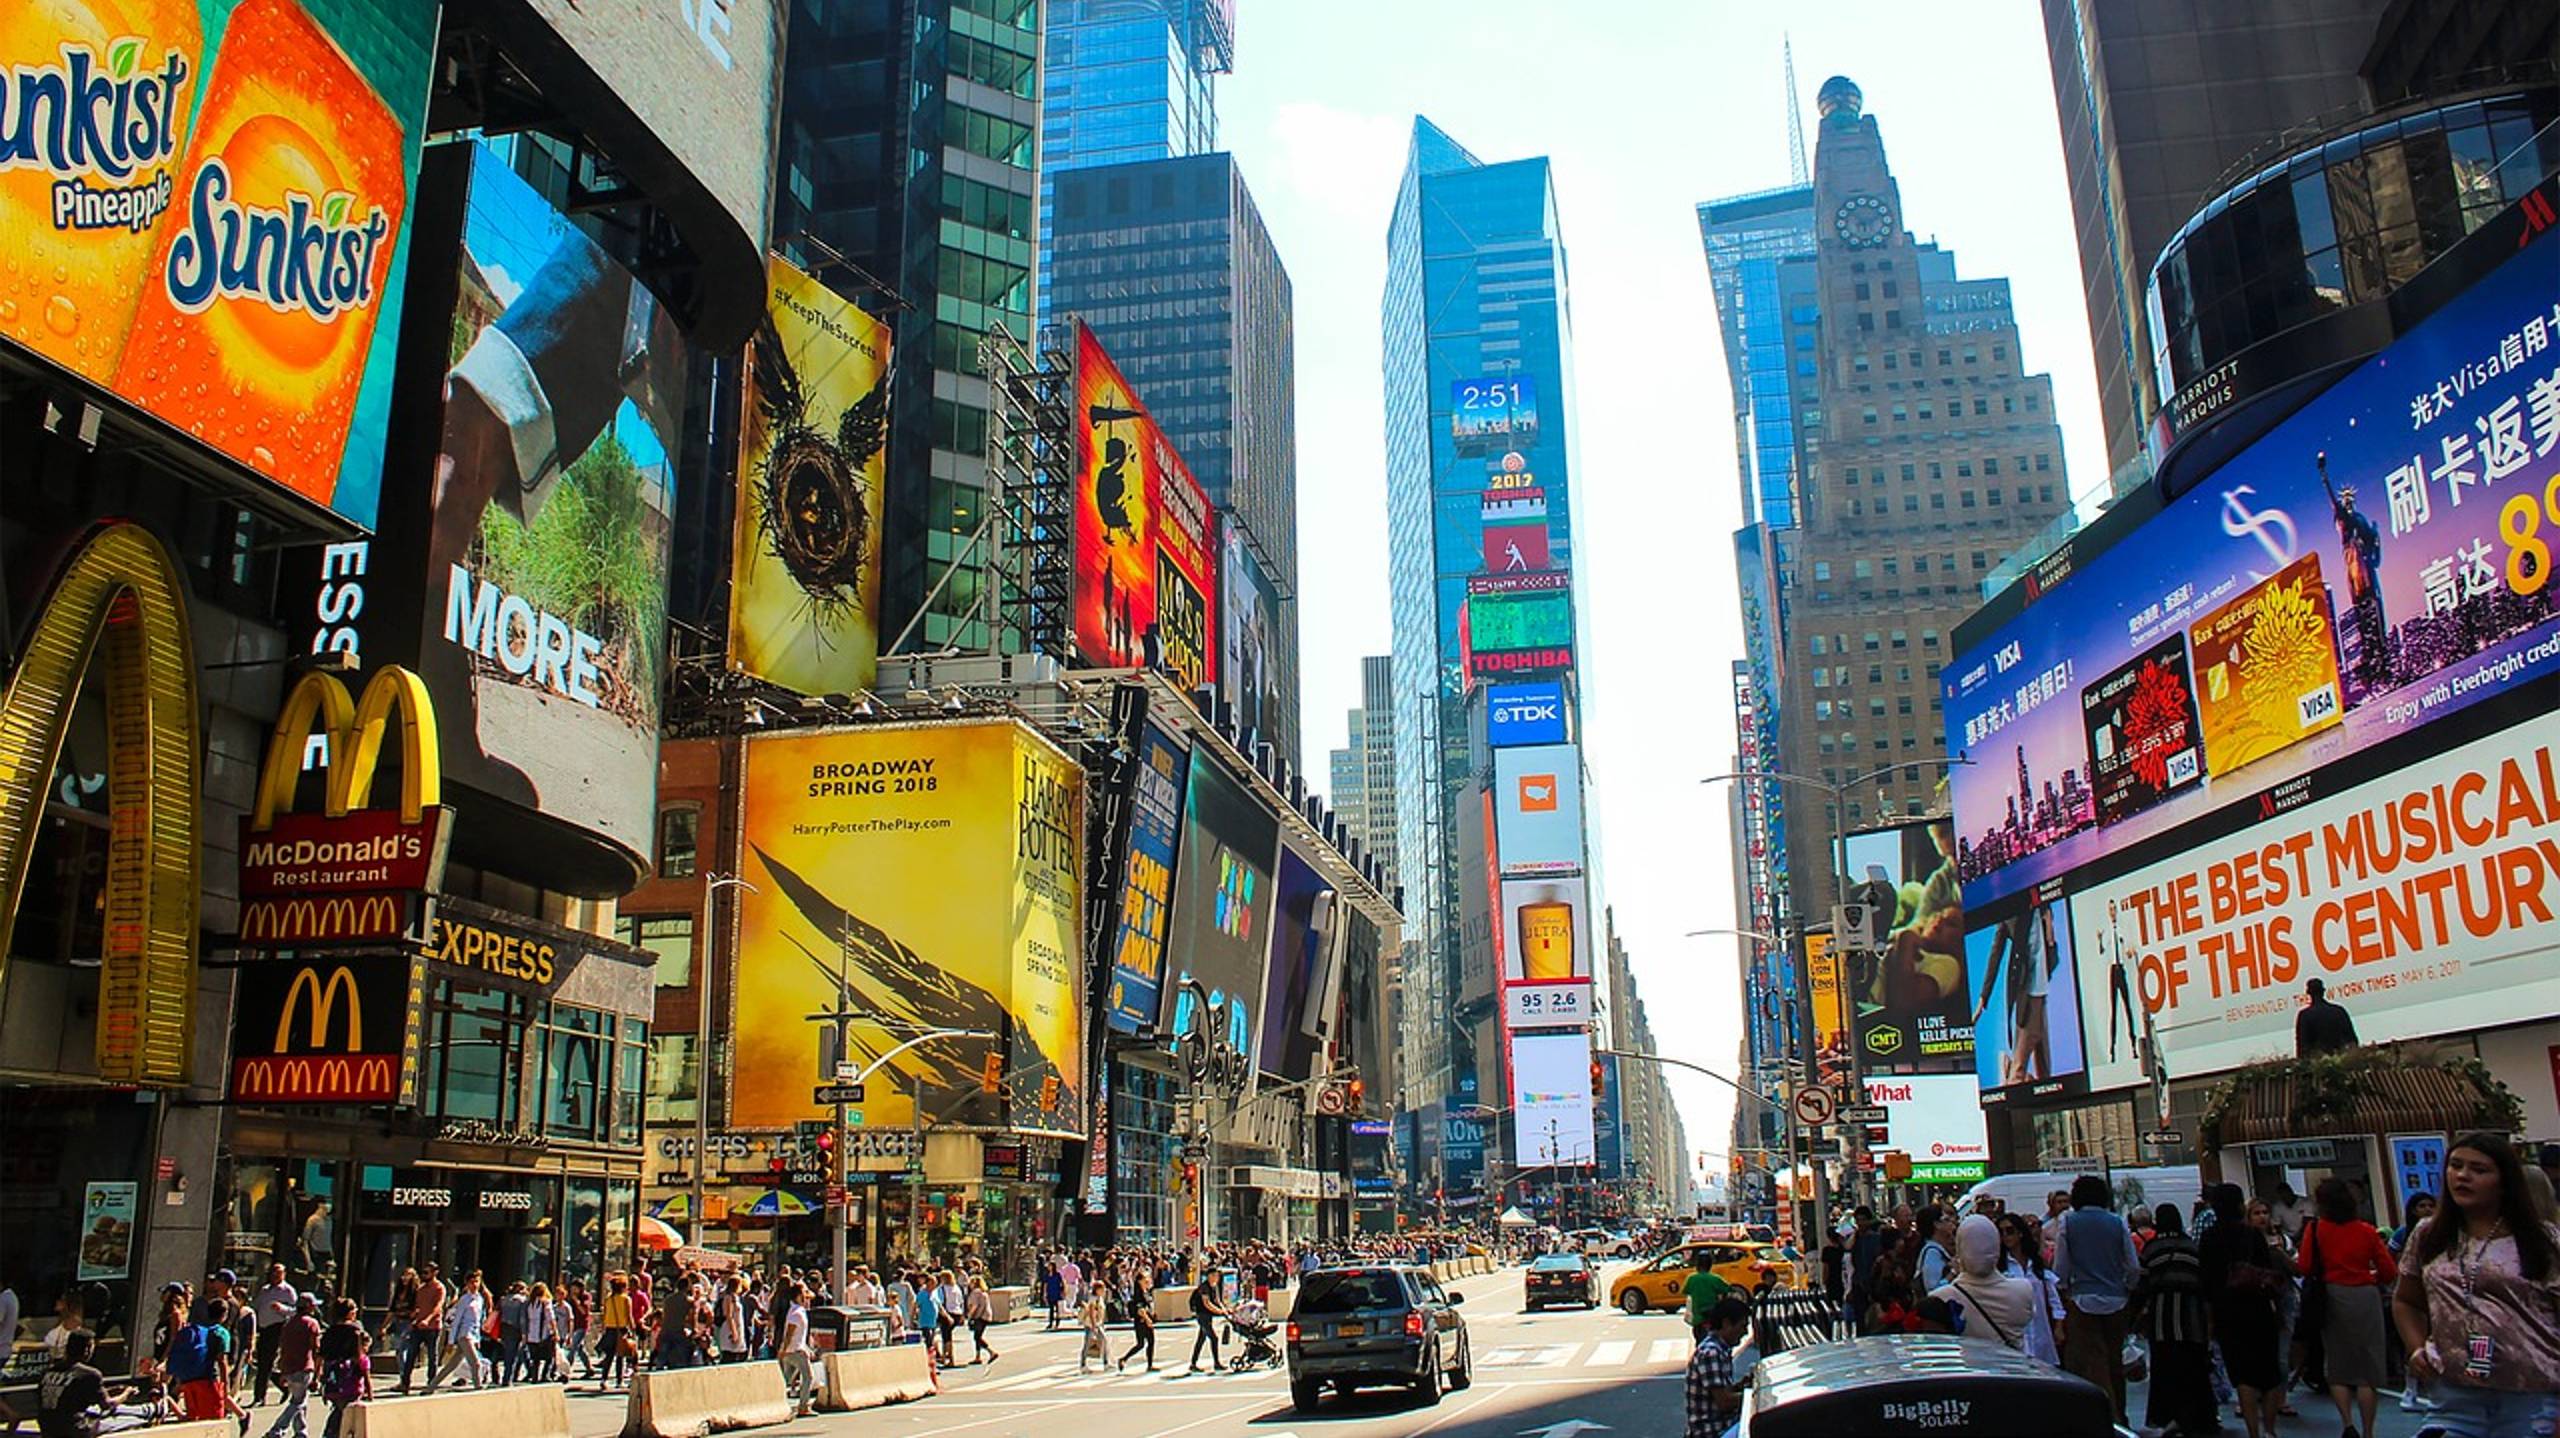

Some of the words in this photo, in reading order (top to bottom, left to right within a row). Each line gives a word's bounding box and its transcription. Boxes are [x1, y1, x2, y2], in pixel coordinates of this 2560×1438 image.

[0, 52, 187, 177] unkist
[55, 171, 172, 232] Pineapple
[168, 163, 387, 316] Sunkist
[774, 287, 877, 361] #KeepTheSecrets
[1463, 383, 1520, 410] 2:51
[2174, 360, 2238, 415] MARRIOTT
[2175, 386, 2232, 433] MARQUIS
[1492, 473, 1533, 489] 2017
[445, 562, 601, 709] MORE
[1472, 650, 1571, 671] TOSHIBA
[1993, 640, 2022, 673] VISA
[2385, 702, 2420, 724] Enjoy
[2421, 682, 2451, 710] with
[2451, 651, 2526, 696] Everbright
[1508, 704, 1558, 722] TDK
[2301, 690, 2333, 719] VISA
[812, 758, 936, 779] BROADWAY
[2171, 755, 2196, 779] VISA
[808, 780, 886, 798] SPRING
[893, 776, 938, 793] 2018
[1021, 753, 1073, 834] HARRY
[792, 817, 952, 837] HarryPotterThePlay.com
[2207, 831, 2314, 925] BEST
[2322, 745, 2560, 889] MUSICAL
[246, 834, 422, 867] McDonald's
[1018, 801, 1079, 882] POTTER
[272, 867, 390, 886] Restaurant
[1129, 849, 1169, 905] COME
[1123, 884, 1166, 944] FROM
[1524, 925, 1569, 939] ULTRA
[1118, 928, 1161, 981] AWAY
[2138, 945, 2189, 1015] OF
[2199, 916, 2300, 1000] THIS
[1811, 977, 1835, 990] KING
[2338, 984, 2365, 999] YORK
[2367, 973, 2397, 995] TIMES
[2401, 969, 2423, 985] MAY
[1521, 993, 1542, 1008] 95
[1552, 992, 1577, 1006] 2.6
[1917, 1018, 1923, 1029] I
[1923, 1015, 1947, 1029] LOVE
[1870, 1033, 1897, 1047] CMT
[1920, 1029, 1949, 1042] KELLIE
[660, 1136, 749, 1158] GITS
[1945, 1145, 1983, 1154] Pinterest
[1935, 1166, 1983, 1178] FRIENDS
[393, 1187, 451, 1207] EXPRESS
[479, 1191, 531, 1210] EXPRESS
[1883, 1399, 1971, 1420] BigBelly
[1919, 1414, 1961, 1429] SOLAR
